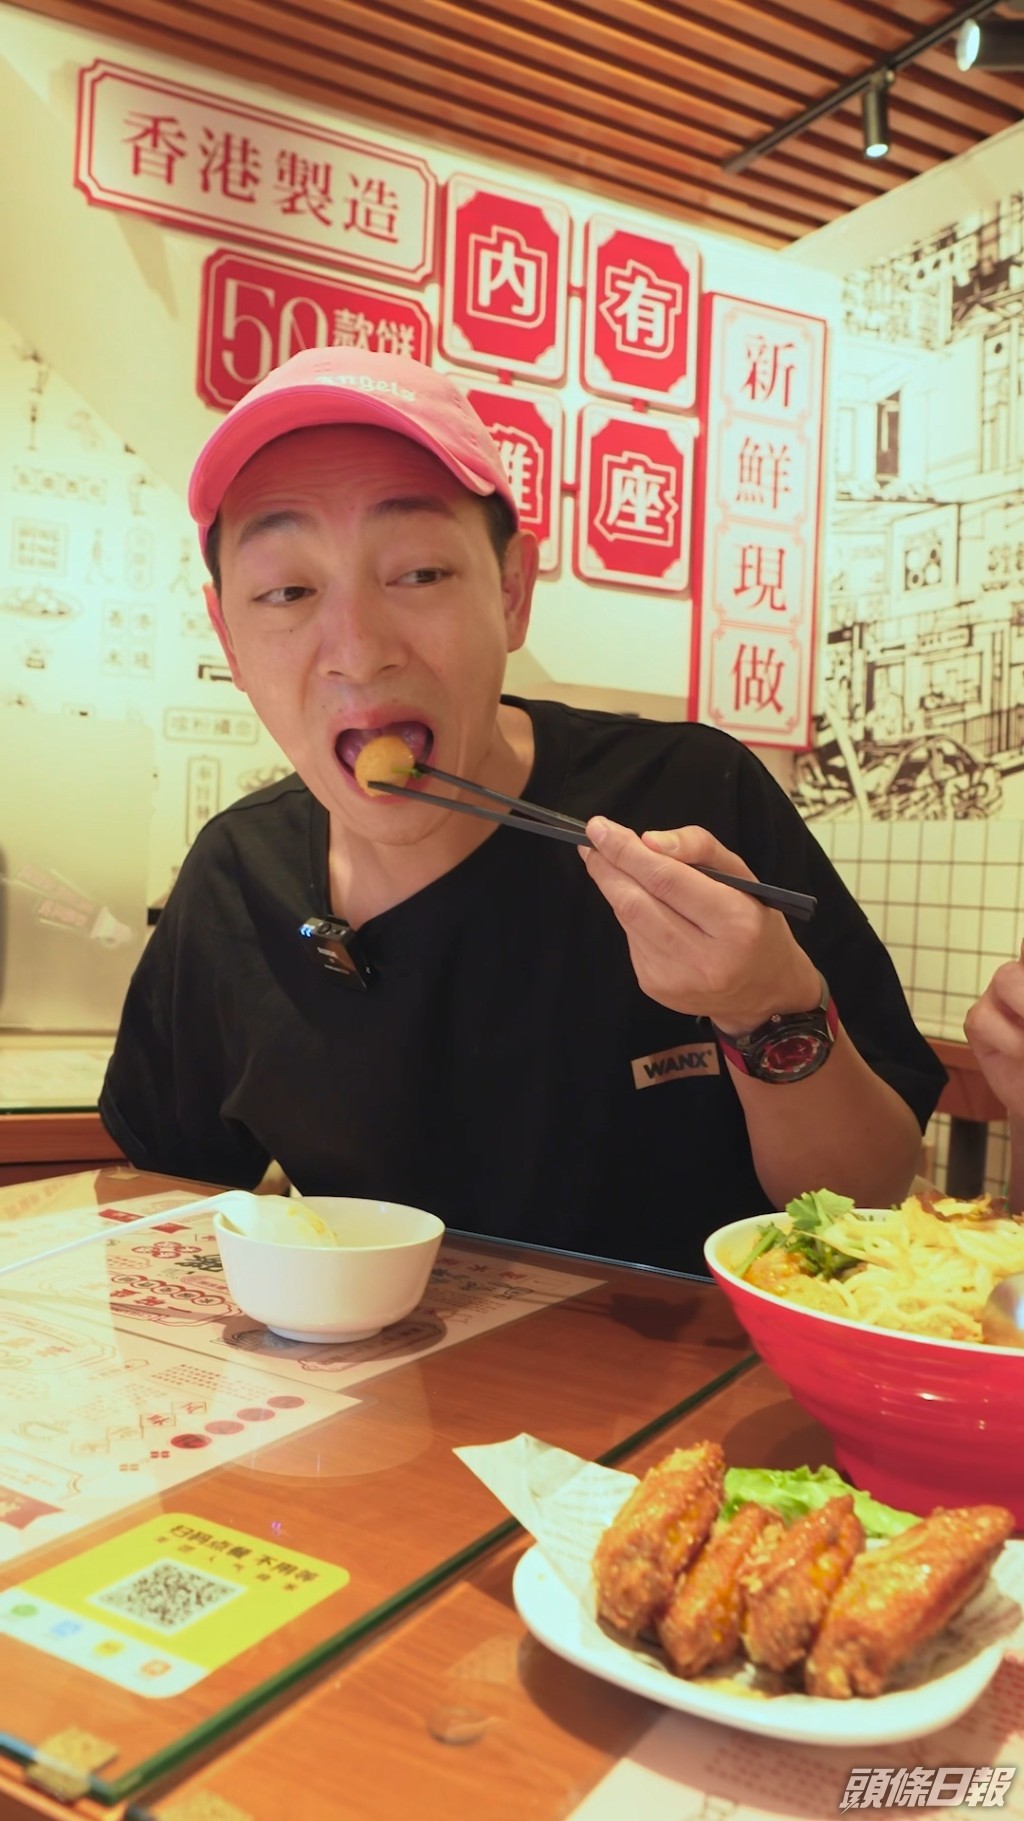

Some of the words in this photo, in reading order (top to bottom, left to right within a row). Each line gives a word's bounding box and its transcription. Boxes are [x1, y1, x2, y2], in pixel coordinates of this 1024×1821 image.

[122, 111, 399, 244] 香港製造
[730, 333, 796, 714] 新鮮現做
[643, 1052, 708, 1079] WANX
